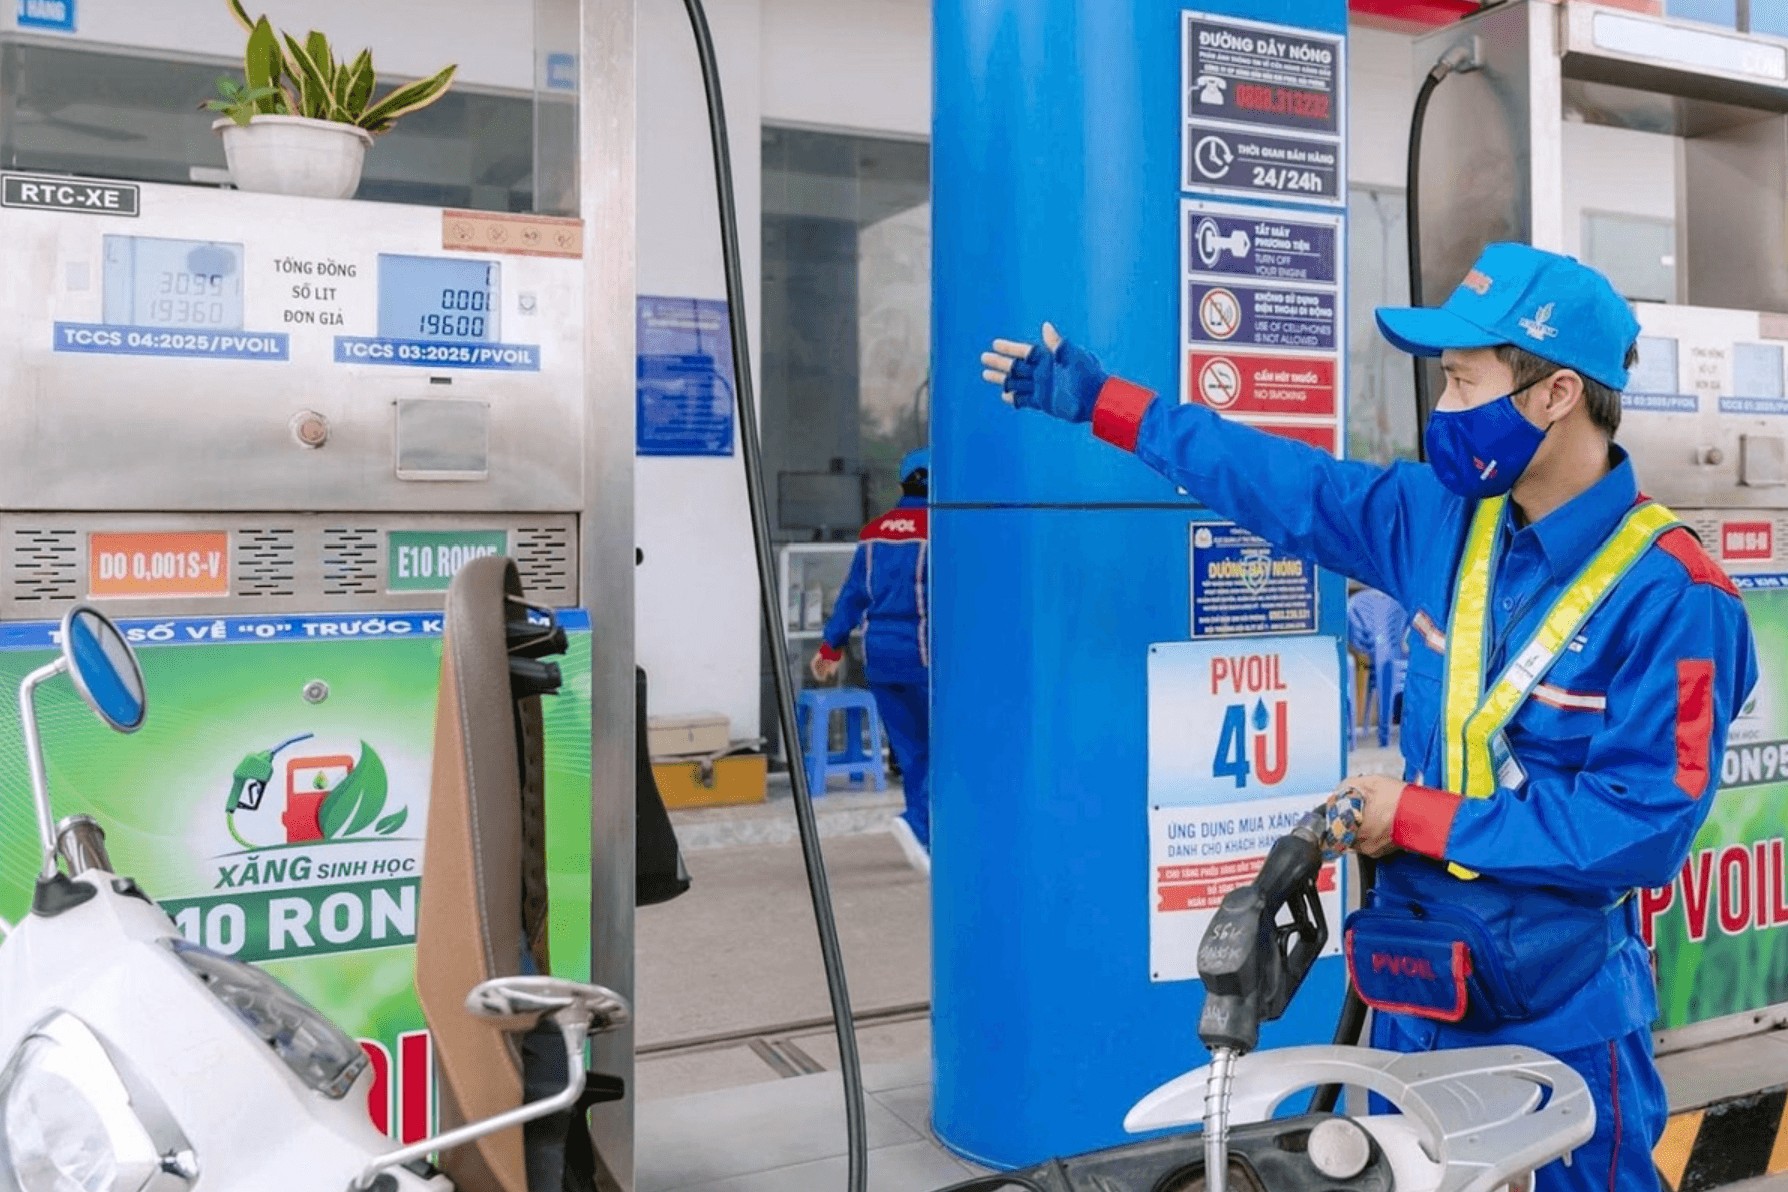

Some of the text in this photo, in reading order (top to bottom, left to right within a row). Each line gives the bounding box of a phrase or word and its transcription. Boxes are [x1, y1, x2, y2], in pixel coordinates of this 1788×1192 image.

[1199, 31, 1332, 64] ĐƯỜNG DÂY NÓNG
[1238, 143, 1335, 165] THỜI GIAN BÁN HÀNG
[1253, 166, 1322, 192] 24/24h
[20, 184, 120, 208] RTC-XE
[1271, 226, 1290, 238] MÁY
[274, 255, 357, 278] TỔNG ĐỒNG
[1254, 254, 1291, 265] TURN OFF
[1254, 266, 1306, 278] YOUR ENGINE
[292, 283, 312, 299] SỐ
[1254, 292, 1283, 303] KHÔNG
[149, 300, 224, 324] 19360
[283, 310, 315, 325] ĐƠN
[419, 313, 484, 337] 19600
[1254, 322, 1332, 335] USE OF CELLPHONES
[64, 329, 280, 353] TCCS 04:2025/PVOIL
[1254, 333, 1318, 345] IS NOT ALLOWED
[343, 341, 532, 364] TCCS 03:2025/PVOIL
[1254, 368, 1318, 384] CẤM HÚT THUỐC
[1254, 389, 1306, 401] NO SMOKING
[100, 551, 222, 582] DO 0,001S-V
[398, 546, 433, 578] E10
[127, 621, 176, 642] SỐ
[186, 619, 227, 639] VỀ
[303, 617, 412, 637] TRƯỚC
[1211, 653, 1288, 695] PVOIL
[1212, 700, 1288, 788] 4U
[1239, 815, 1264, 833] MUA
[1201, 841, 1222, 856] CHO
[214, 855, 416, 889] XĂNG SINH HỌC
[1641, 838, 1788, 948] PVOIL
[174, 902, 246, 956] 10
